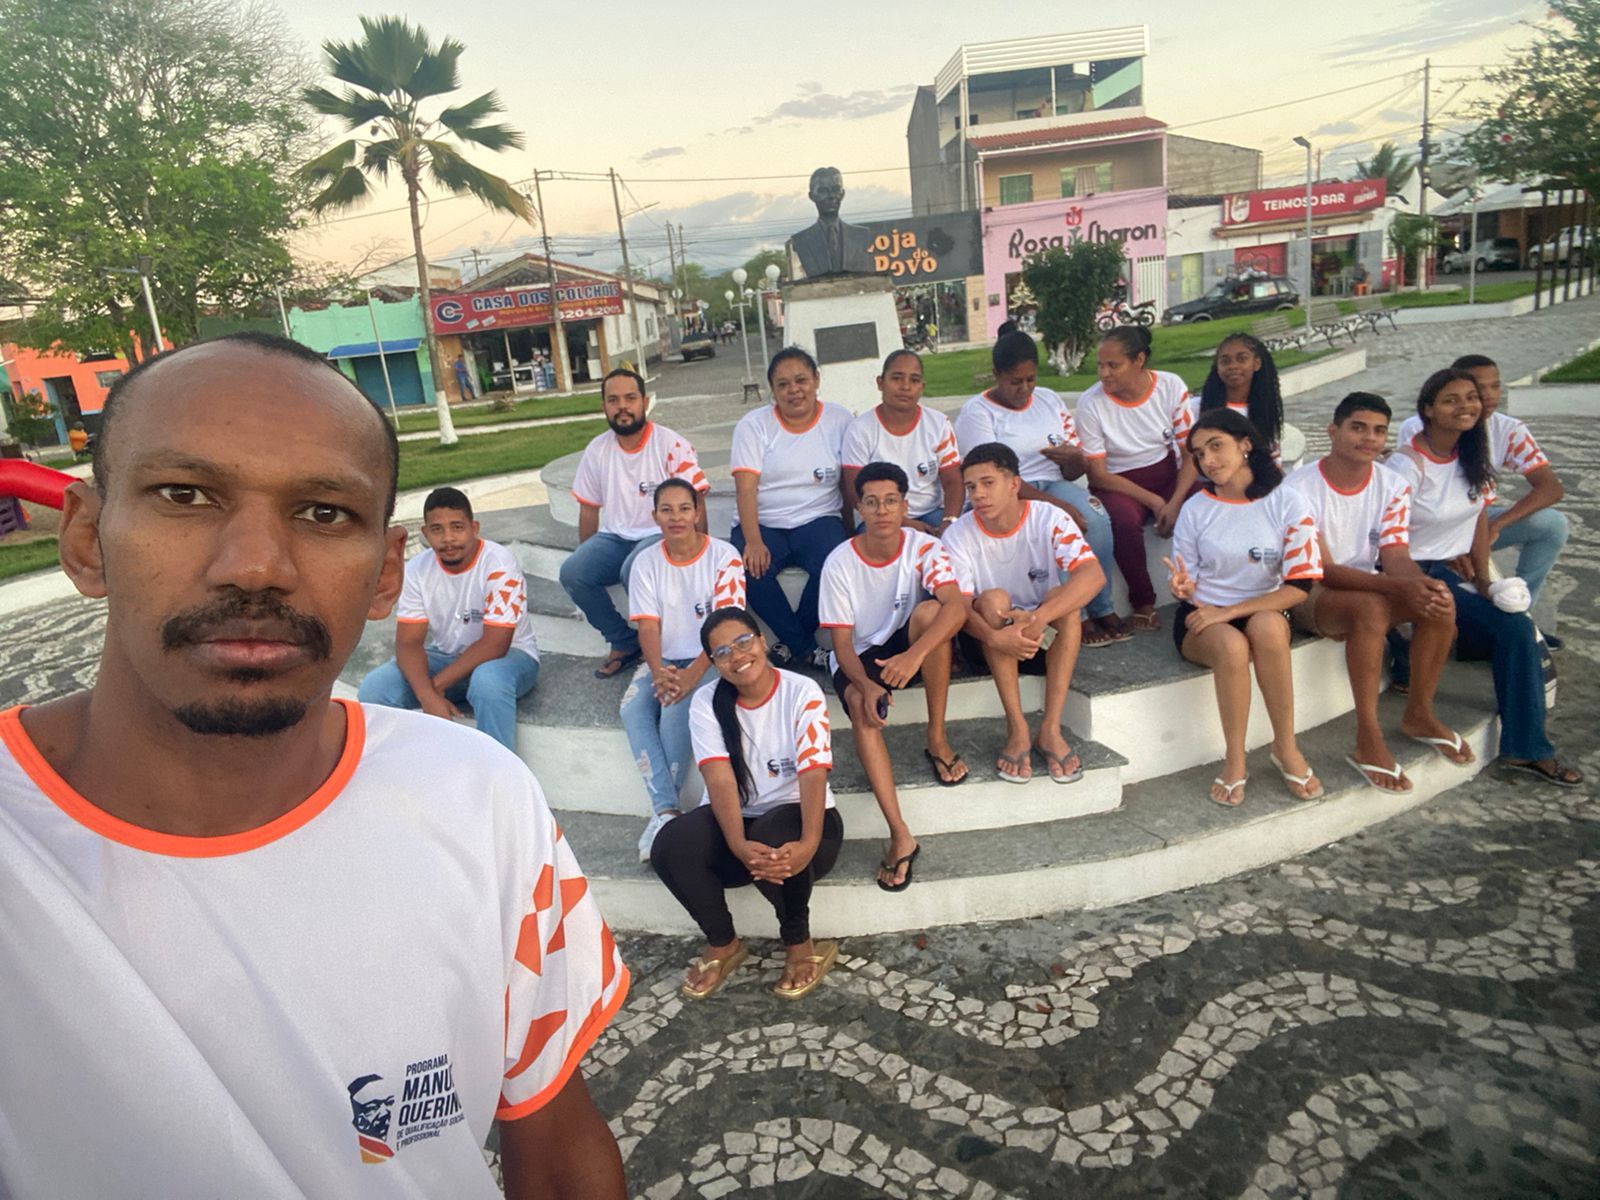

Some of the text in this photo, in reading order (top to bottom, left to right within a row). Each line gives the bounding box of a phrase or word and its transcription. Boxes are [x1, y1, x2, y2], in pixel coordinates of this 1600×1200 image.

[1262, 195, 1319, 211] TEIMOSO
[1321, 192, 1346, 205] BAR
[866, 228, 917, 257] oja
[1008, 227, 1063, 259] Rosa
[473, 293, 515, 313] CASA
[518, 291, 550, 307] DOS
[406, 1054, 448, 1077] PROGRAMA
[402, 1062, 454, 1102] MANU
[398, 1091, 462, 1127] QUERIN
